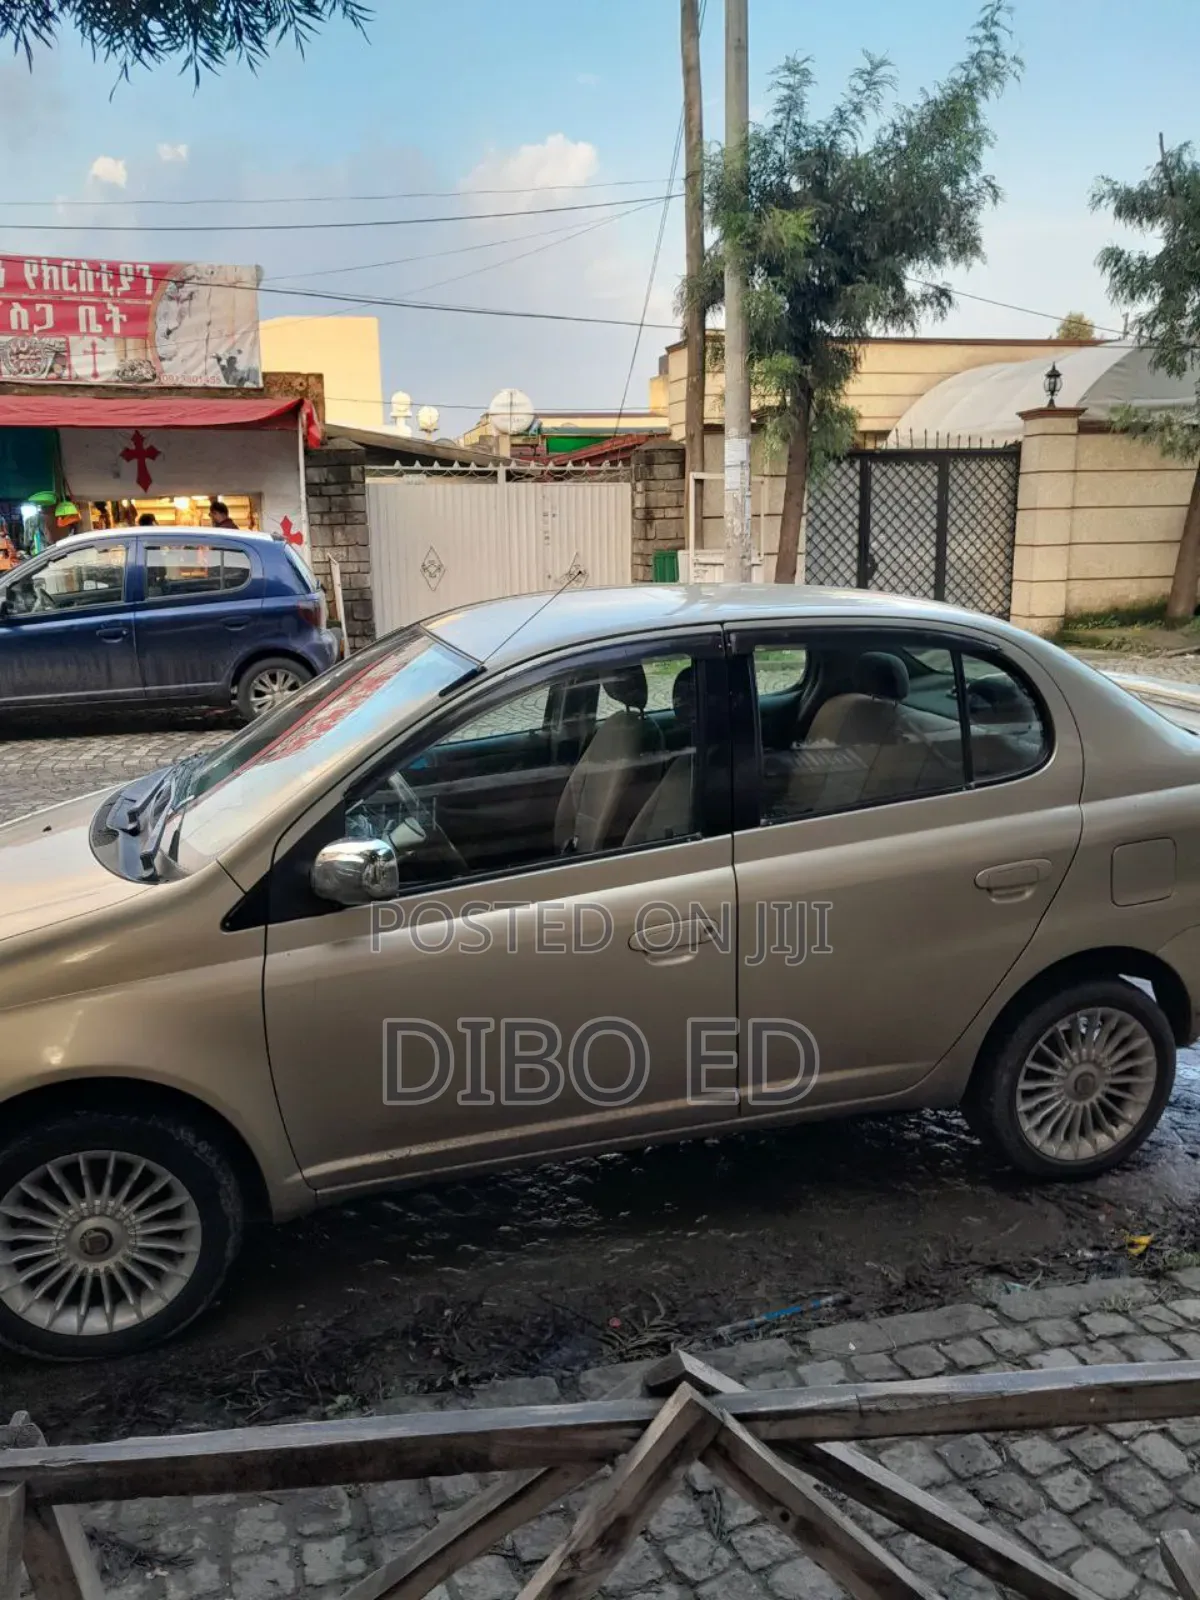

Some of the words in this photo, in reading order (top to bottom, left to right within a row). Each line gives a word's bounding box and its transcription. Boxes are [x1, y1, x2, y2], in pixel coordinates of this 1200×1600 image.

[24, 258, 154, 296] የክርስቲያን
[10, 302, 54, 333] ስጋ
[78, 300, 128, 334] ቤት
